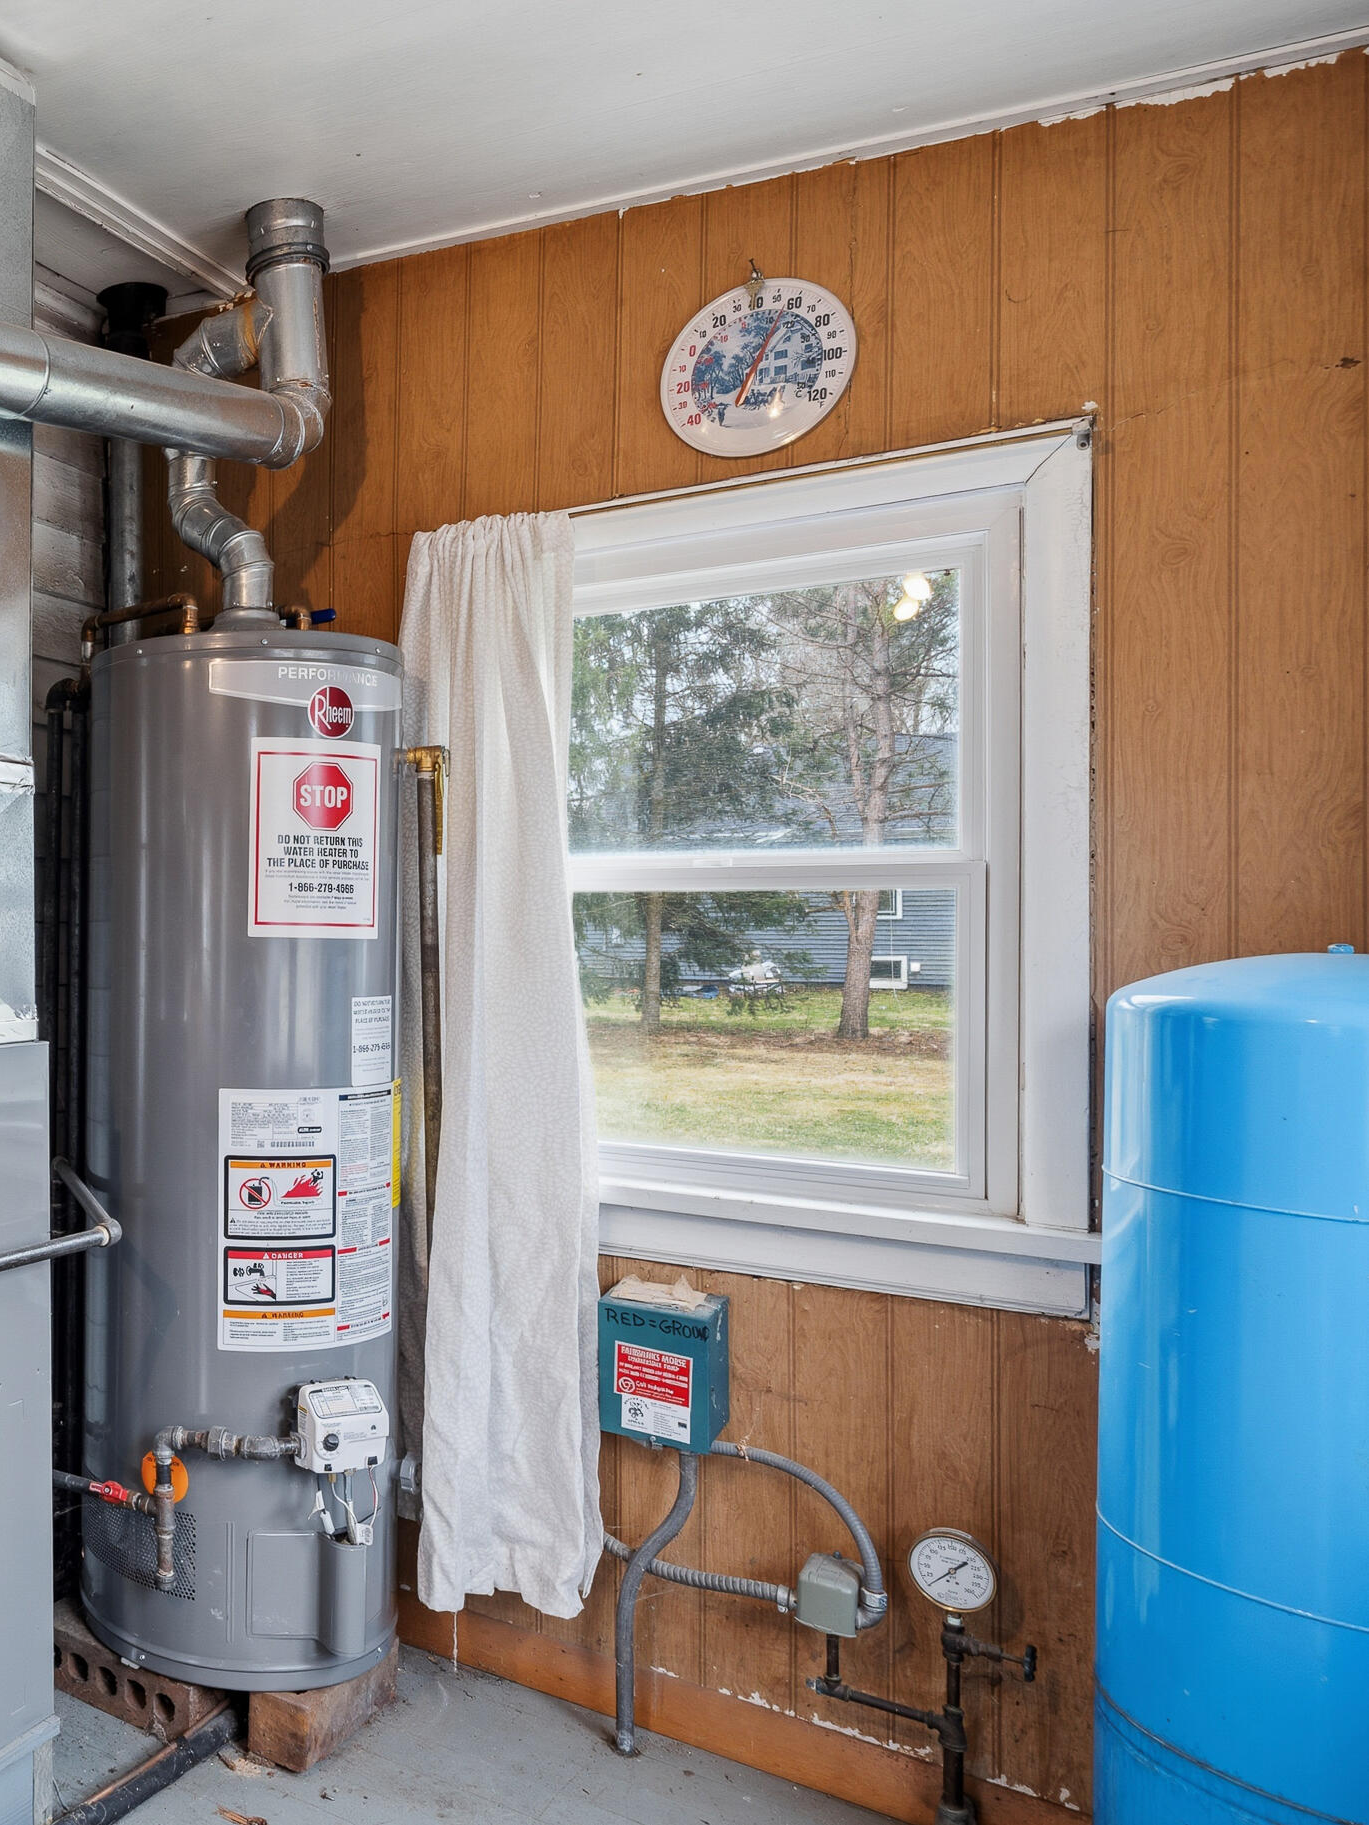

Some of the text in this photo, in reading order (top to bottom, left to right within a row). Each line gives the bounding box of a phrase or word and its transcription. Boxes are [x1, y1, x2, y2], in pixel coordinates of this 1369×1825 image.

[733, 304, 741, 313] 30
[787, 297, 802, 309] 60
[807, 305, 815, 313] 70
[712, 315, 726, 328] 20
[815, 314, 830, 327] 80
[827, 331, 836, 339] 90
[689, 345, 696, 357] 0
[824, 347, 842, 360] 100
[825, 370, 836, 378] 110
[677, 381, 690, 394] 20
[807, 388, 827, 401] 120
[687, 414, 701, 425] 40
[315, 687, 351, 730] Rheem
[300, 784, 347, 808] STOP
[278, 835, 363, 847] DO NOT RETURN THIS
[284, 847, 358, 858] WATER HEATER TO
[267, 858, 369, 870] THE PLACE OF PURCHASE
[662, 1355, 686, 1368] MORSE
